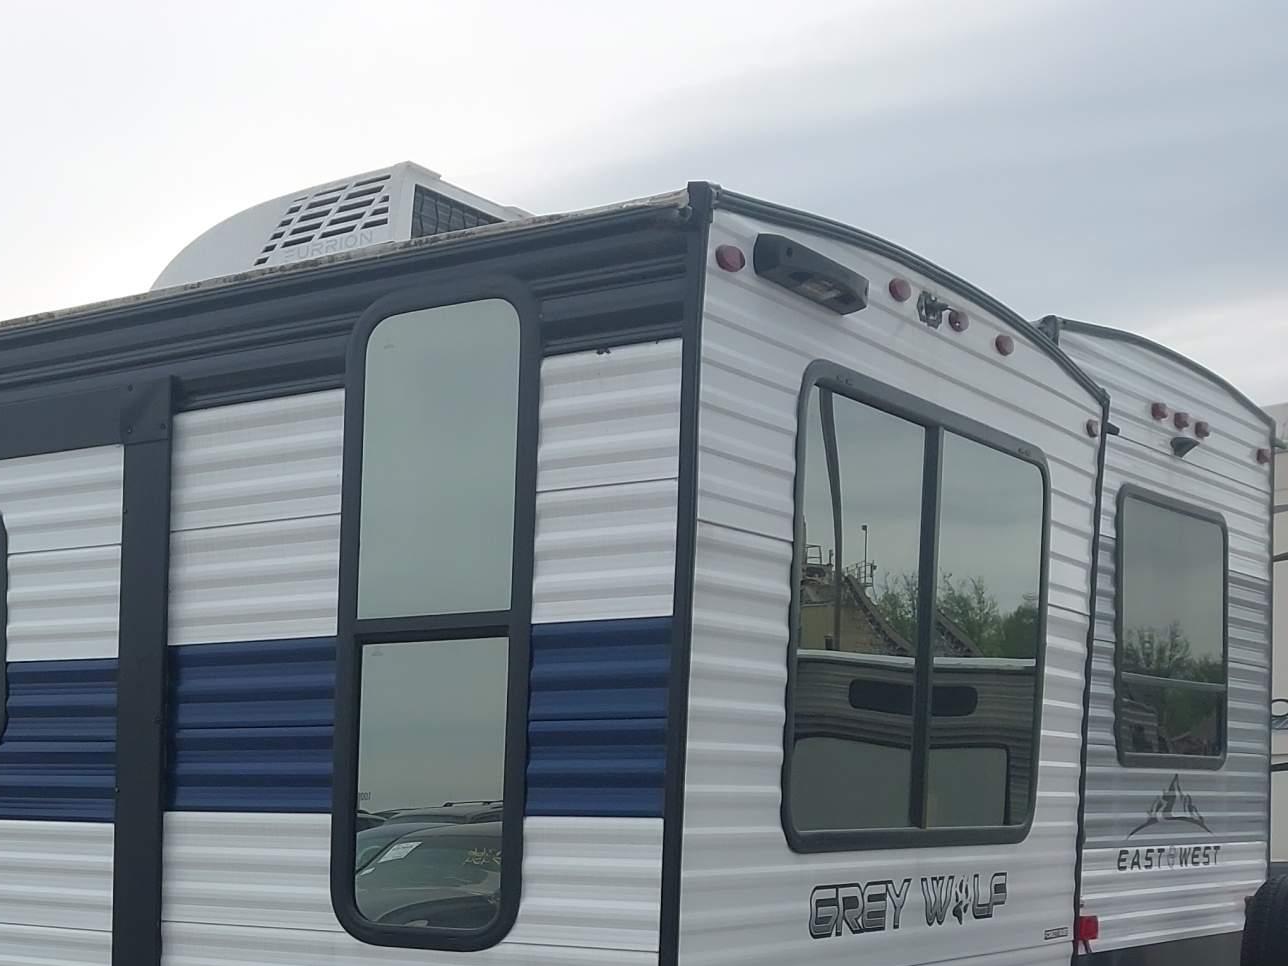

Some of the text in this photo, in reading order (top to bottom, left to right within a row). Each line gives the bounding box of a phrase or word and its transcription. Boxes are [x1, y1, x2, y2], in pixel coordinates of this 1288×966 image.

[1117, 846, 1221, 871] EAST WEST
[809, 878, 912, 939] GREY
